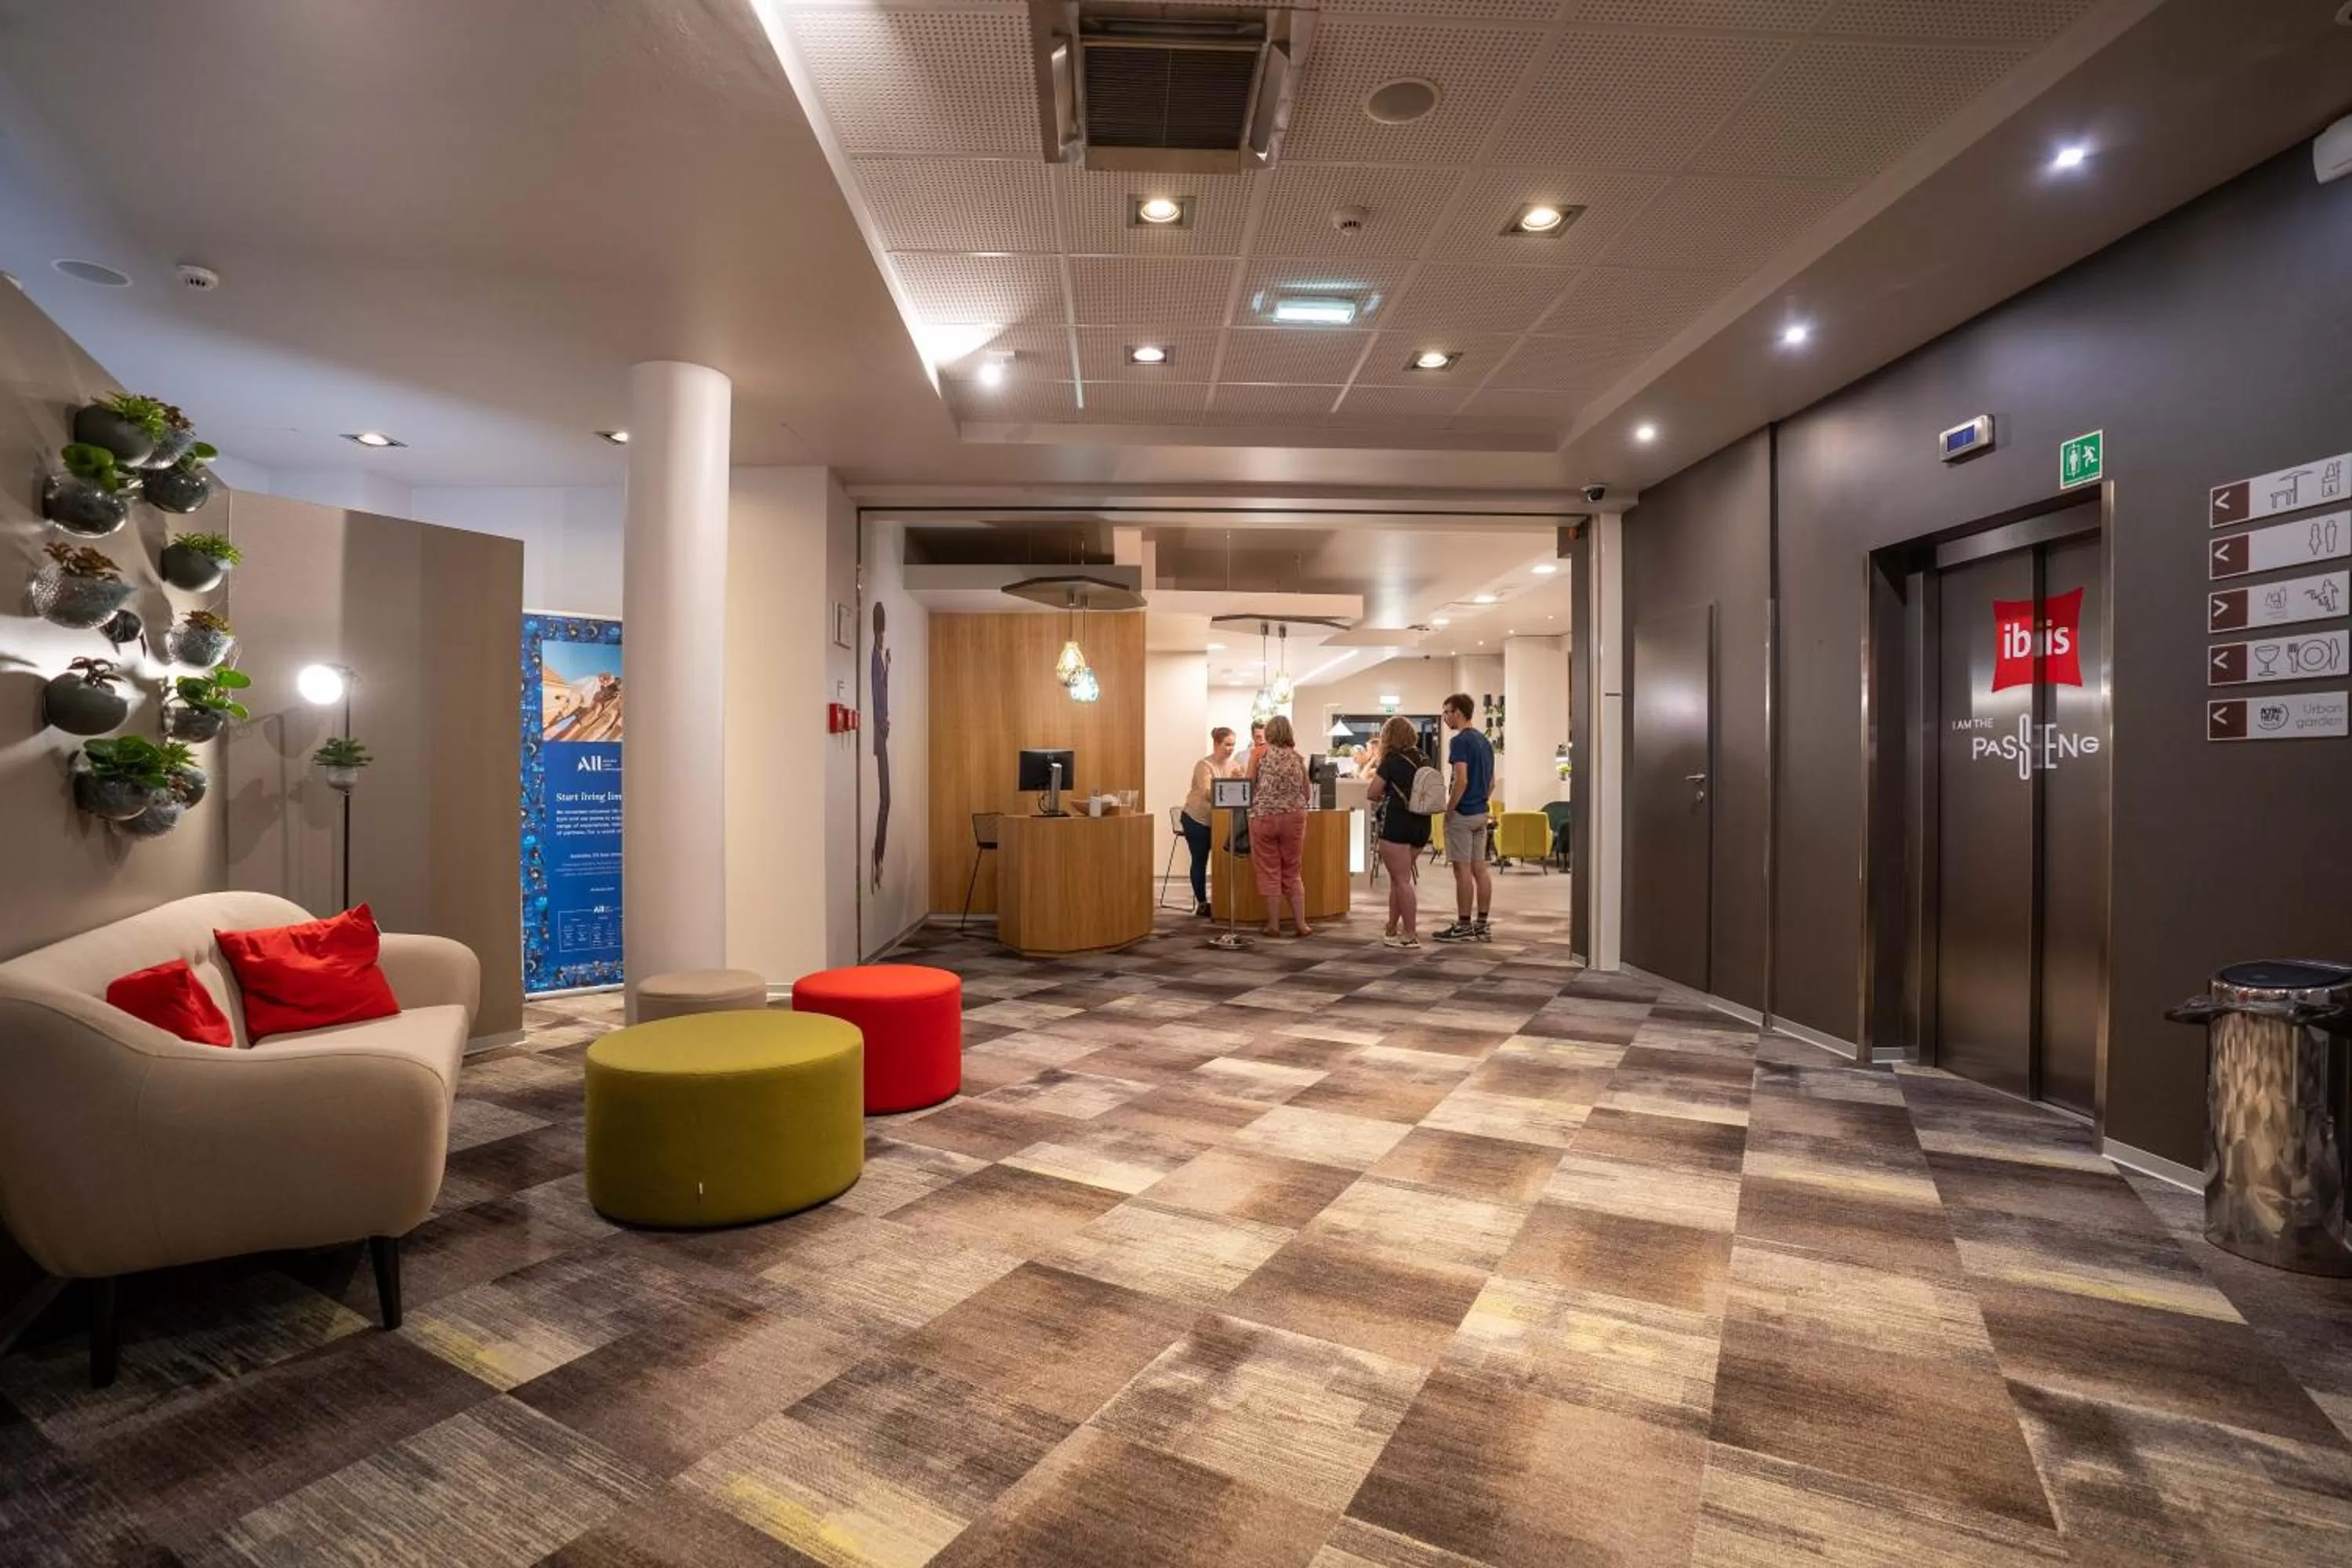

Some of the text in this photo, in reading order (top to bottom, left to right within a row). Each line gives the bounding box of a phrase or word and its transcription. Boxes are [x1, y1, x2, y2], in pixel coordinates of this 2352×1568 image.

[2004, 619, 2070, 659] ibis
[1957, 719, 1971, 730] AM
[1973, 717, 1994, 728] THE
[556, 793, 578, 801] Start
[581, 791, 606, 804] living
